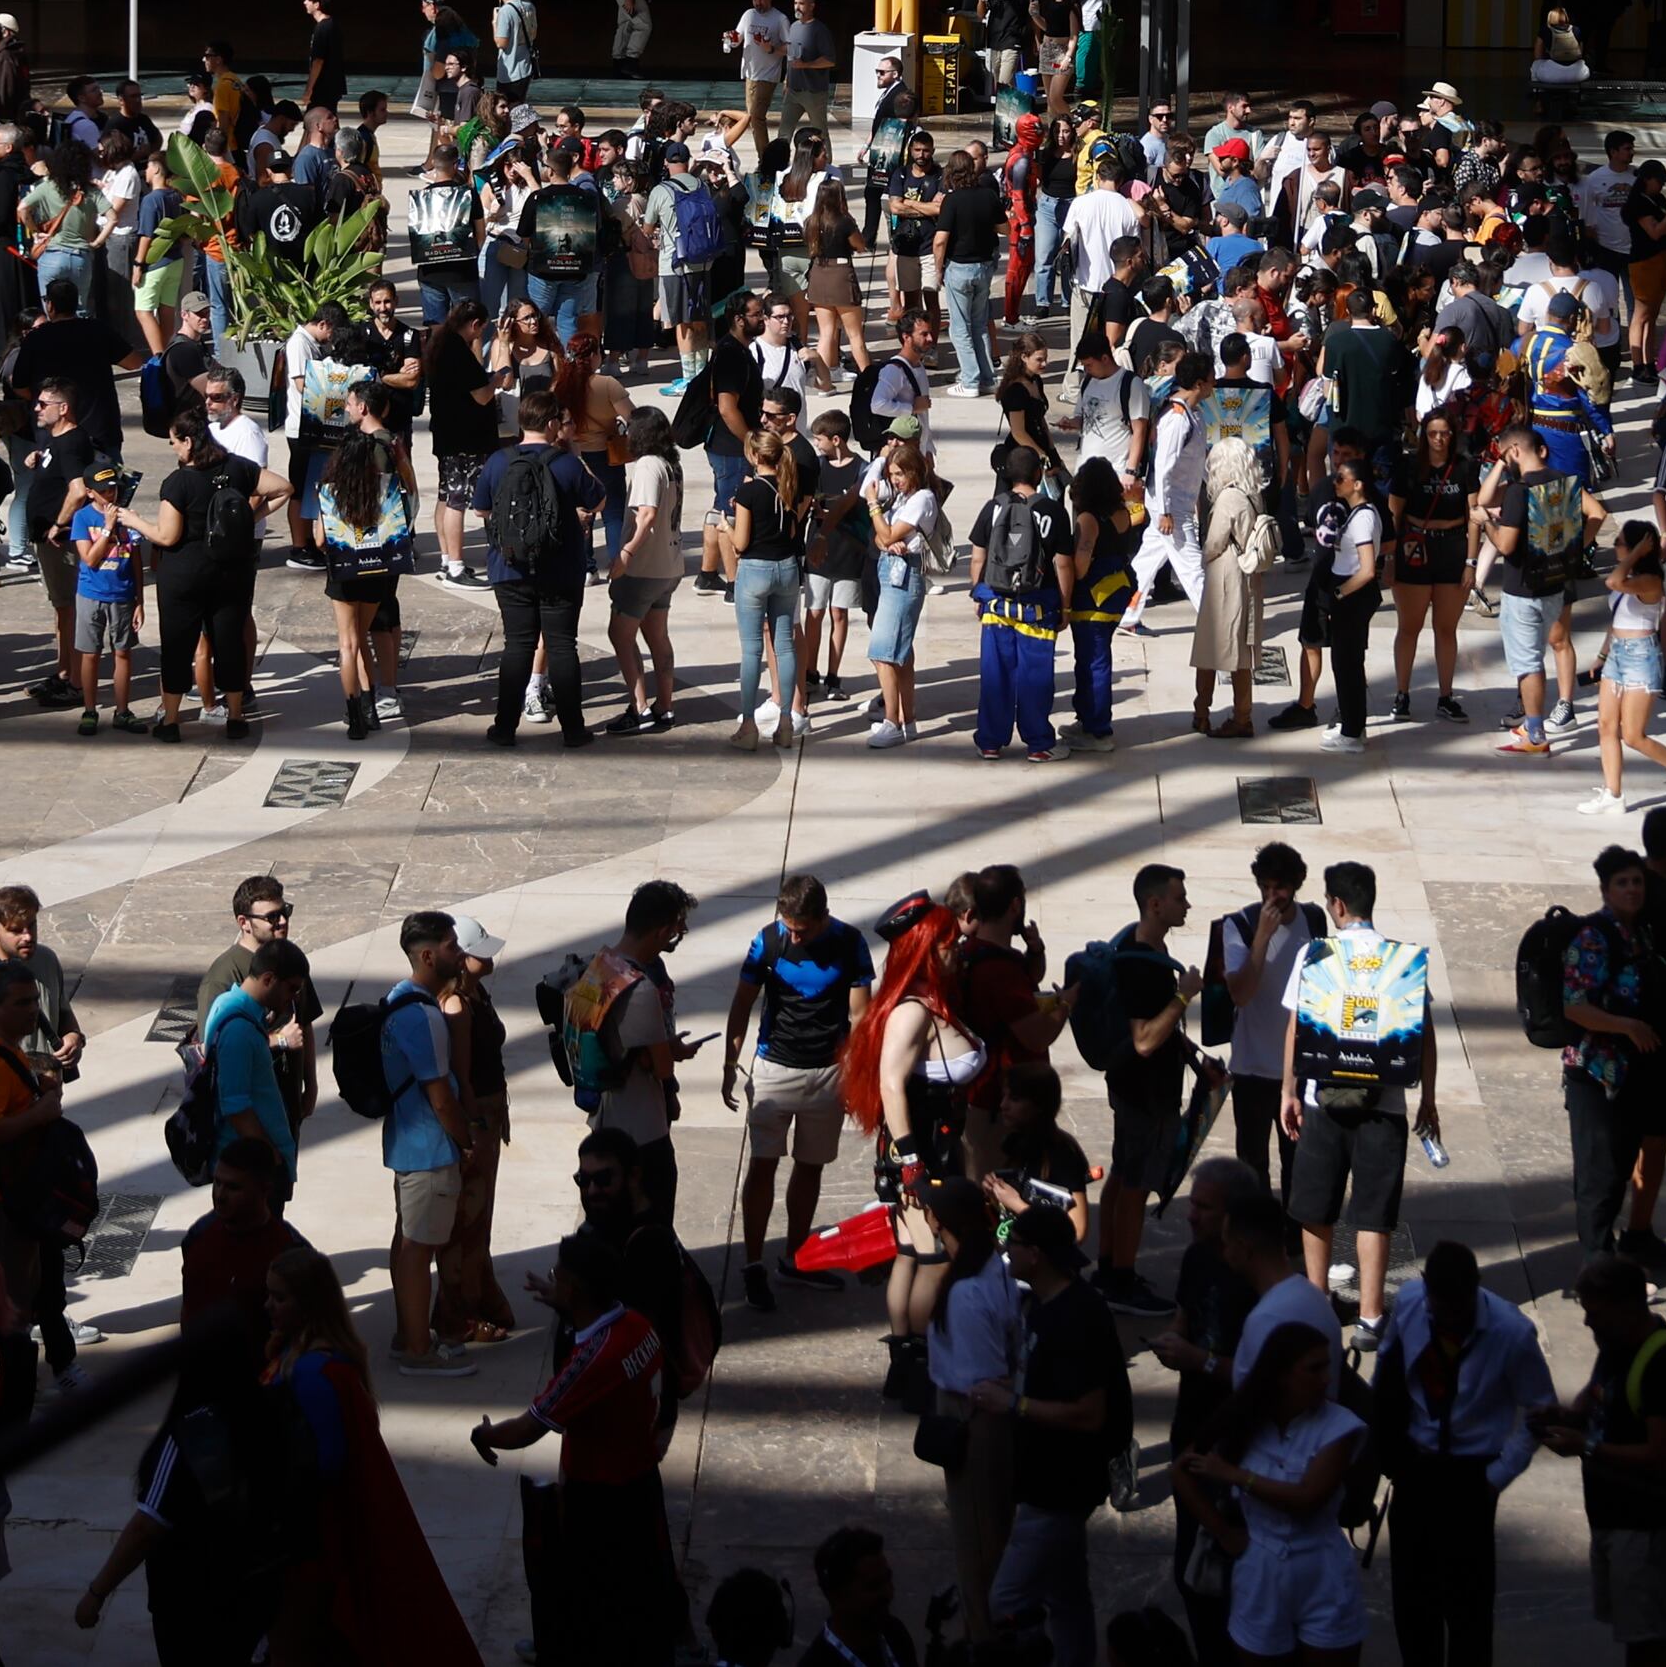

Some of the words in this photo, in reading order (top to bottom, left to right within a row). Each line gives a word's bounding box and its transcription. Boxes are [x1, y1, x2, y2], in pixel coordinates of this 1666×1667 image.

[1349, 956, 1383, 970] 2025
[1342, 995, 1355, 1031] COMIC
[1355, 996, 1379, 1009] CON
